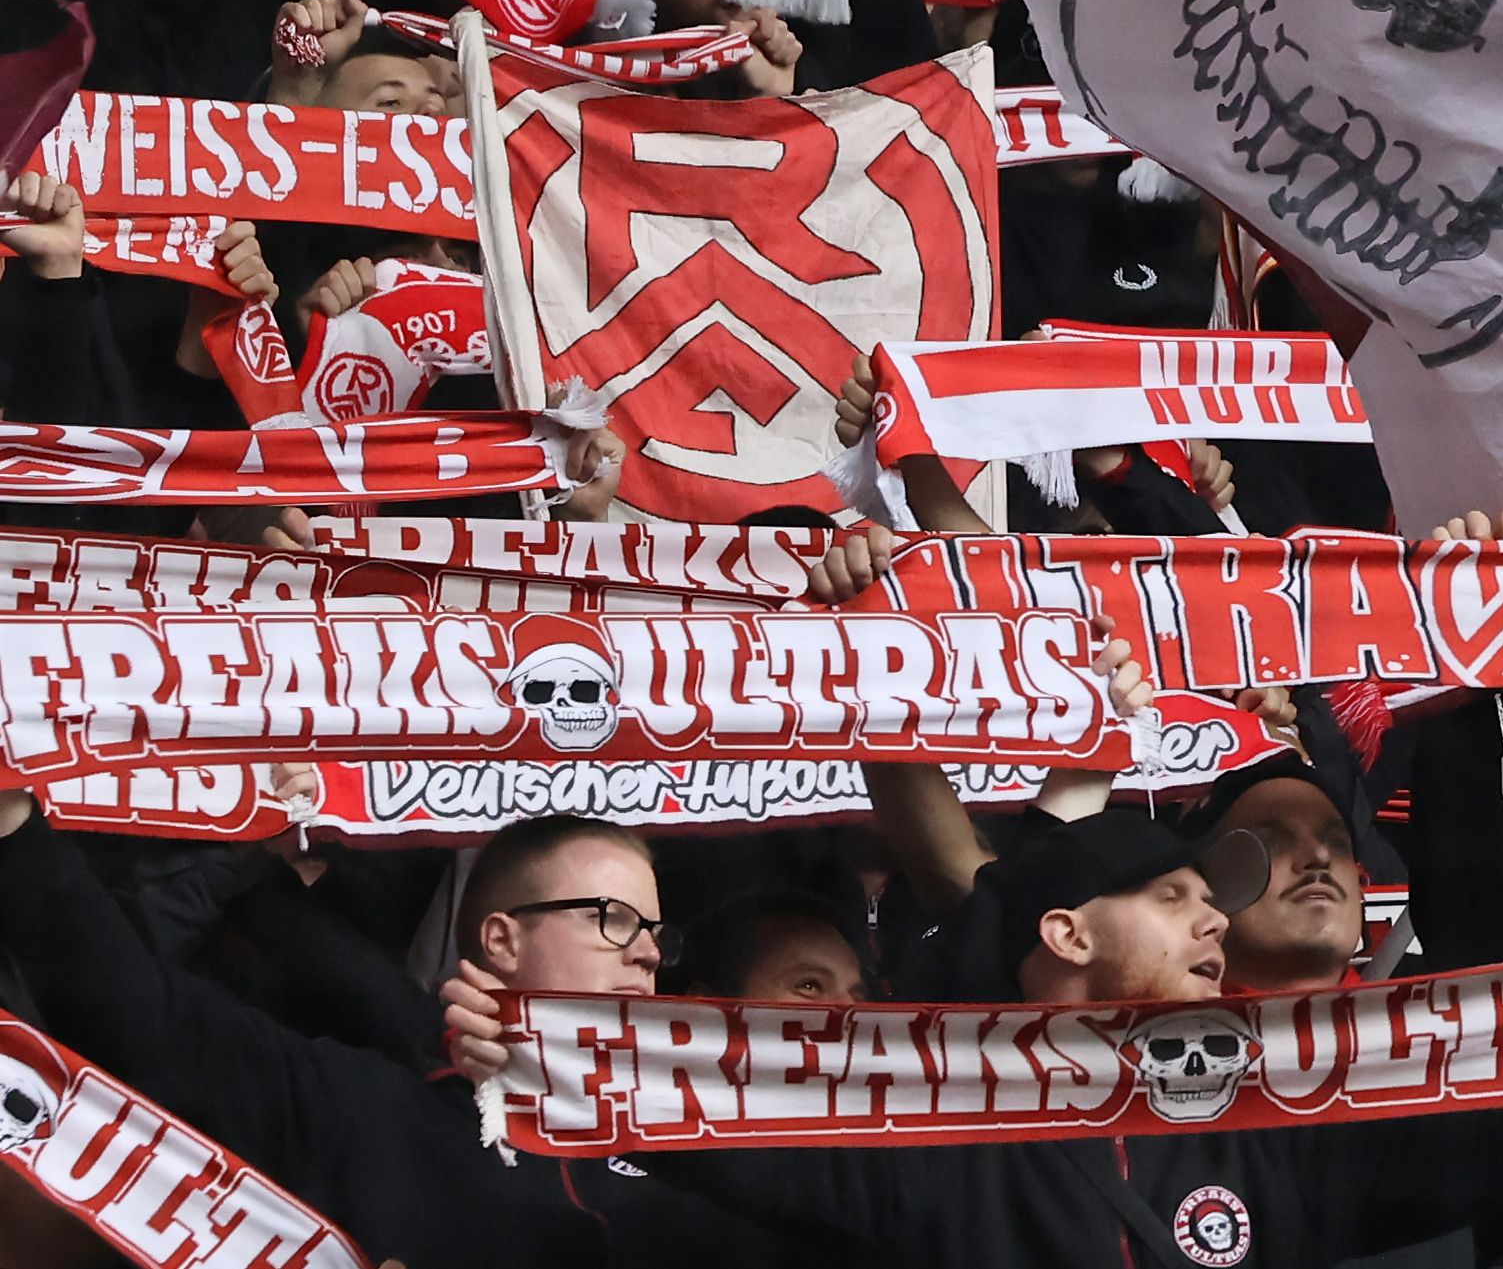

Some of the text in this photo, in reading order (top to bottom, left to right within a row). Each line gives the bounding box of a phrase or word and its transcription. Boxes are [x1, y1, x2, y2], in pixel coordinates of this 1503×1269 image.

[391, 308, 458, 346] 1907
[0, 614, 1100, 764] FREAKS ULTRAS
[369, 760, 670, 820] Deutscher
[532, 994, 1128, 1132] FREAKS
